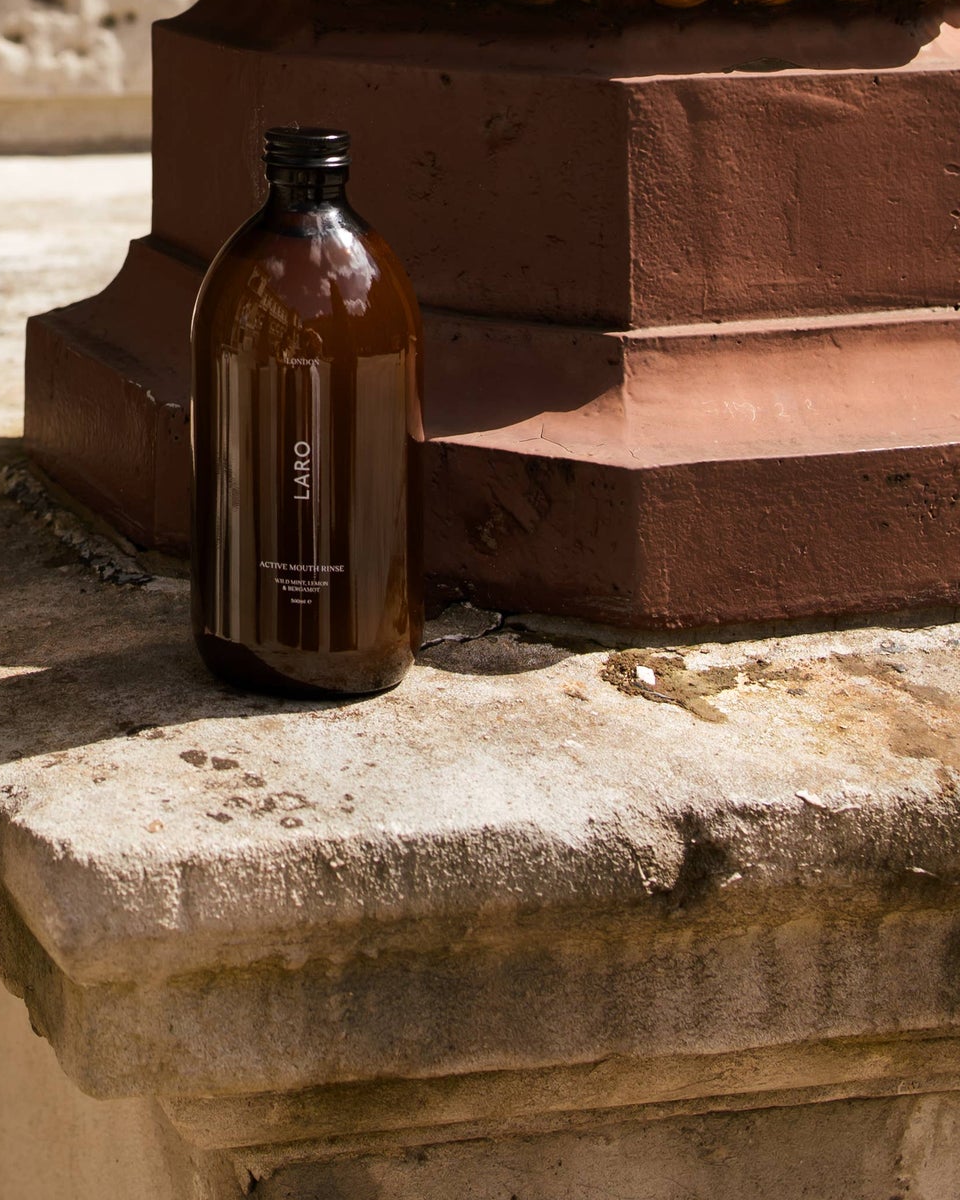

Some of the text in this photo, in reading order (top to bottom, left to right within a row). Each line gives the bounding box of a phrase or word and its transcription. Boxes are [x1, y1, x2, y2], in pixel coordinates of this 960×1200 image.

[286, 357, 320, 366] LONDON
[293, 441, 311, 500] LARO
[259, 560, 344, 573] ACTIVE MOUTH RINSE
[274, 577, 290, 585] WILD
[287, 585, 321, 593] BERGAMOT
